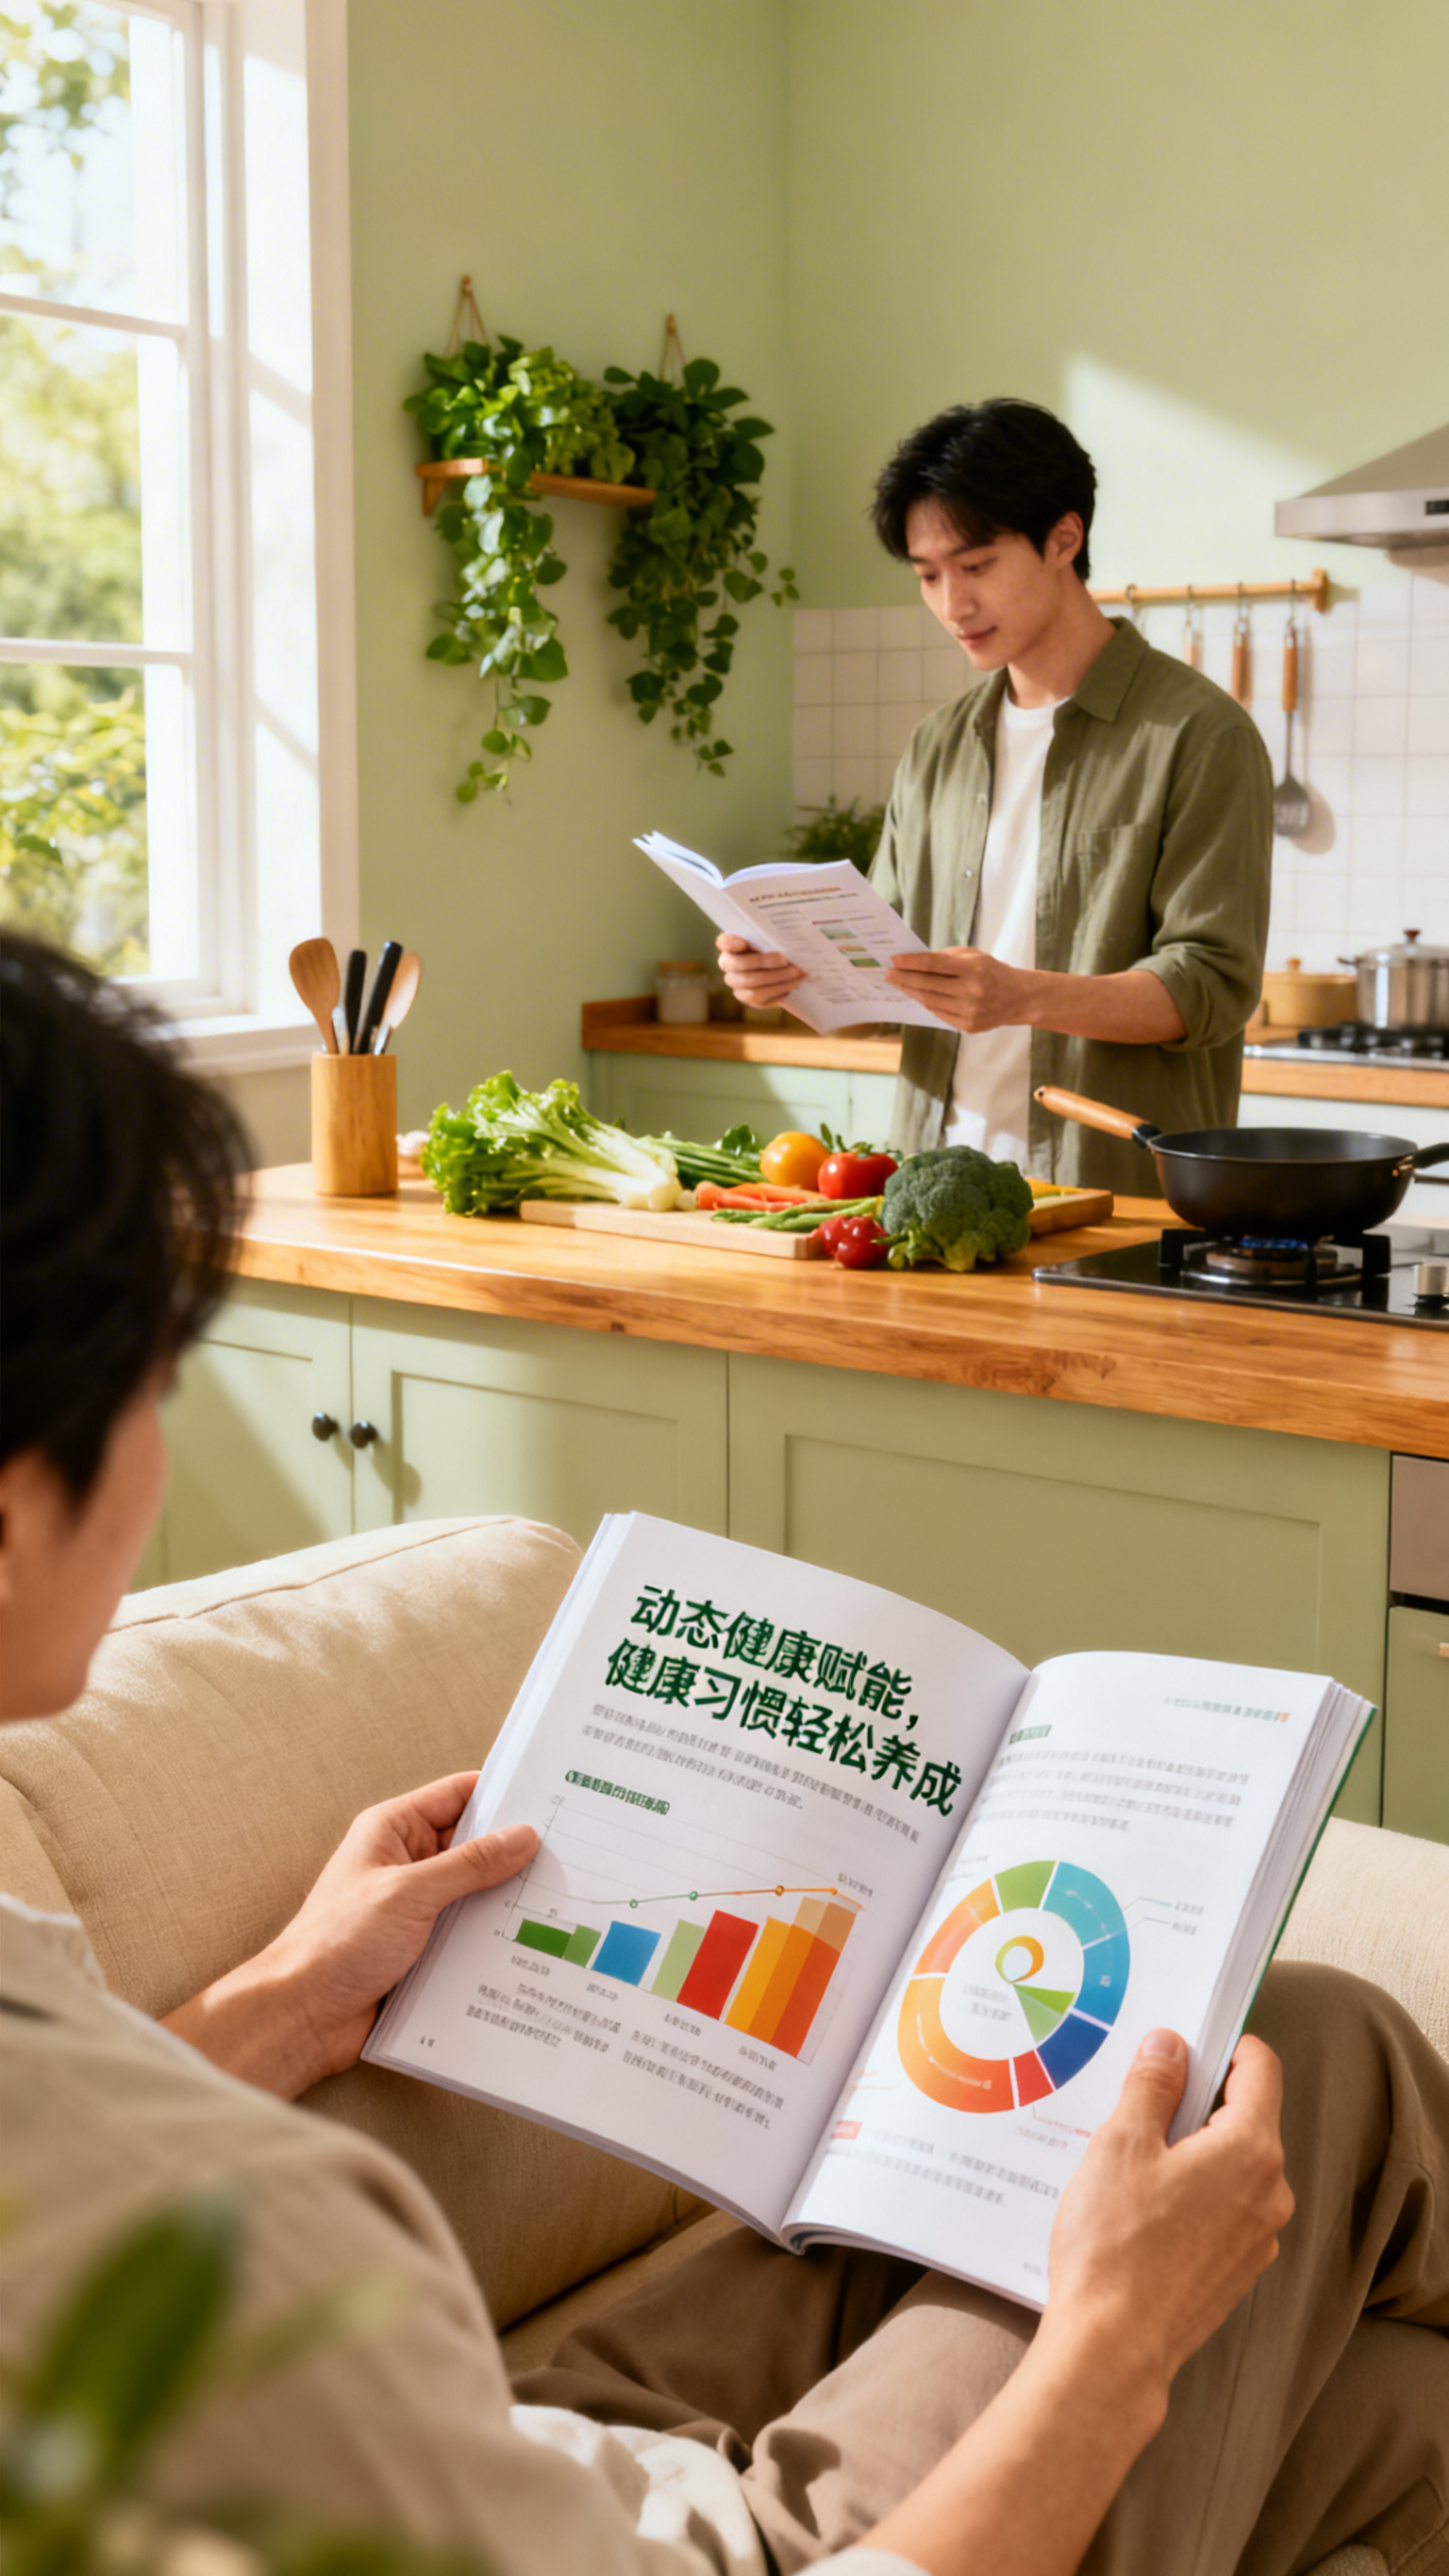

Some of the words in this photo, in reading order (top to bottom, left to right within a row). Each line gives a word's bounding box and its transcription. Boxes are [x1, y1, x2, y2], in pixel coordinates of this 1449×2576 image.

[605, 1637, 963, 1817] 健康习惯轻松养成
